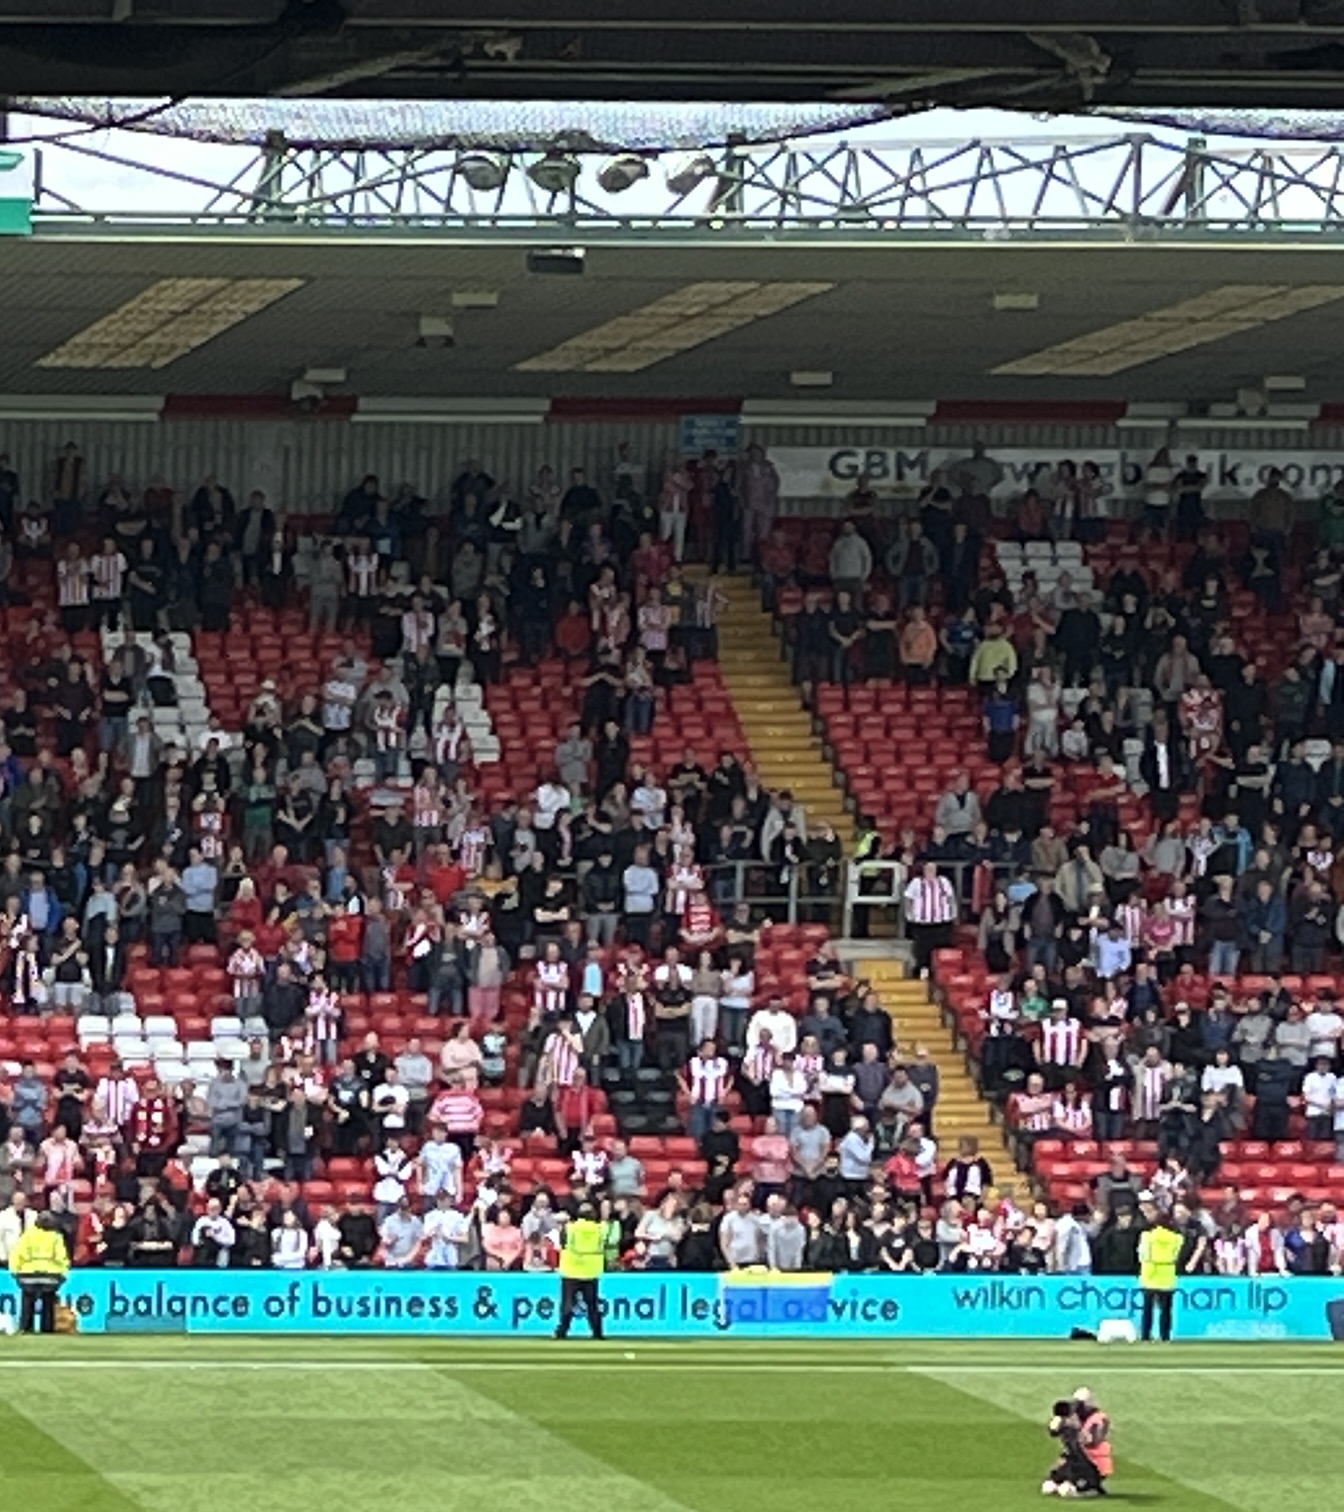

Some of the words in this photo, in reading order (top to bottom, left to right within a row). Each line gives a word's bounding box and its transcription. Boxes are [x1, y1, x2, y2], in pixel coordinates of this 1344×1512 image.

[828, 450, 929, 481] GBM
[111, 1281, 249, 1318] balance
[263, 1281, 301, 1317] of
[313, 1281, 459, 1319] business
[472, 1286, 498, 1320] &
[511, 1285, 666, 1329] peonal
[952, 1282, 1046, 1310] wilkin
[1247, 1282, 1287, 1315] llp
